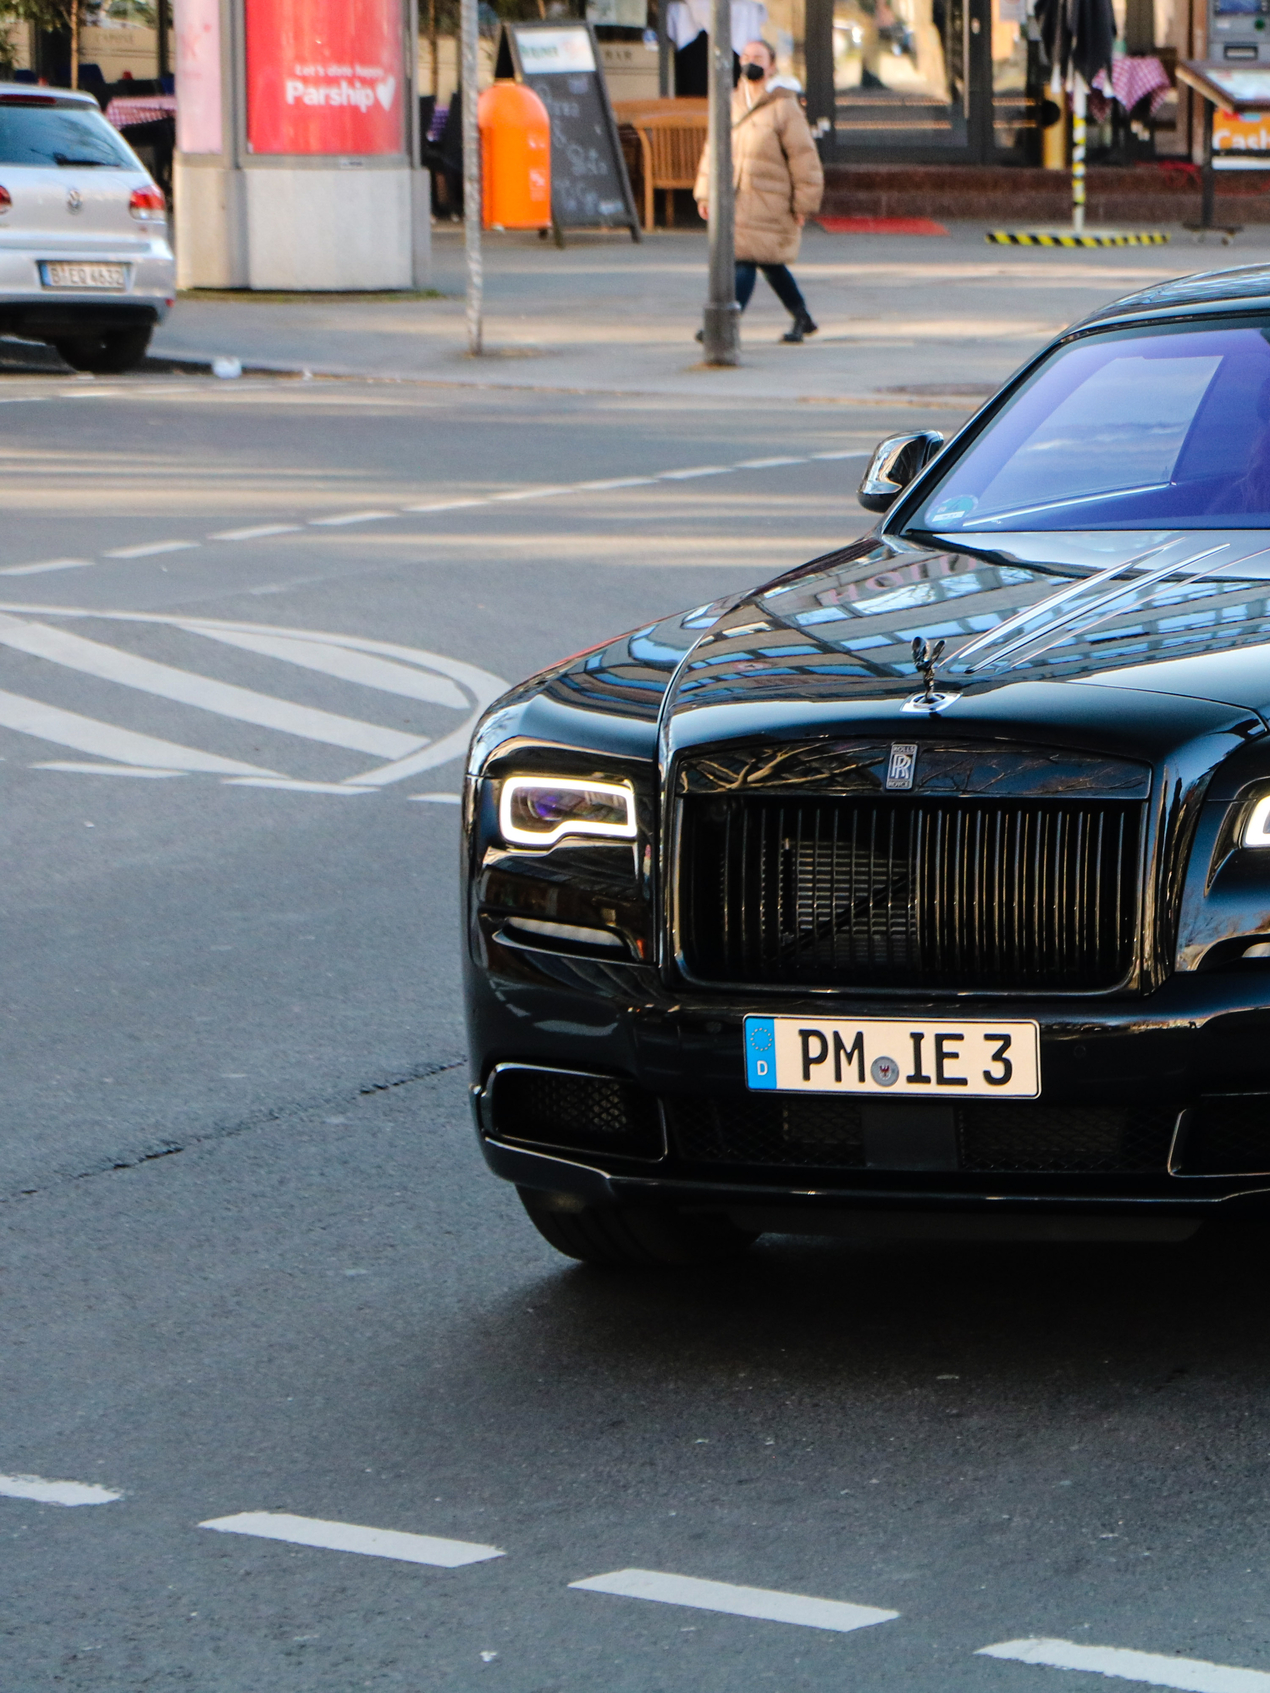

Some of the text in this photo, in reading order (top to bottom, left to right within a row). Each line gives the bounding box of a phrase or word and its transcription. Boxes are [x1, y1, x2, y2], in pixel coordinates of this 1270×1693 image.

[286, 80, 375, 113] Parship
[757, 1060, 769, 1076] D
[799, 1028, 1013, 1086] PM IE 3
